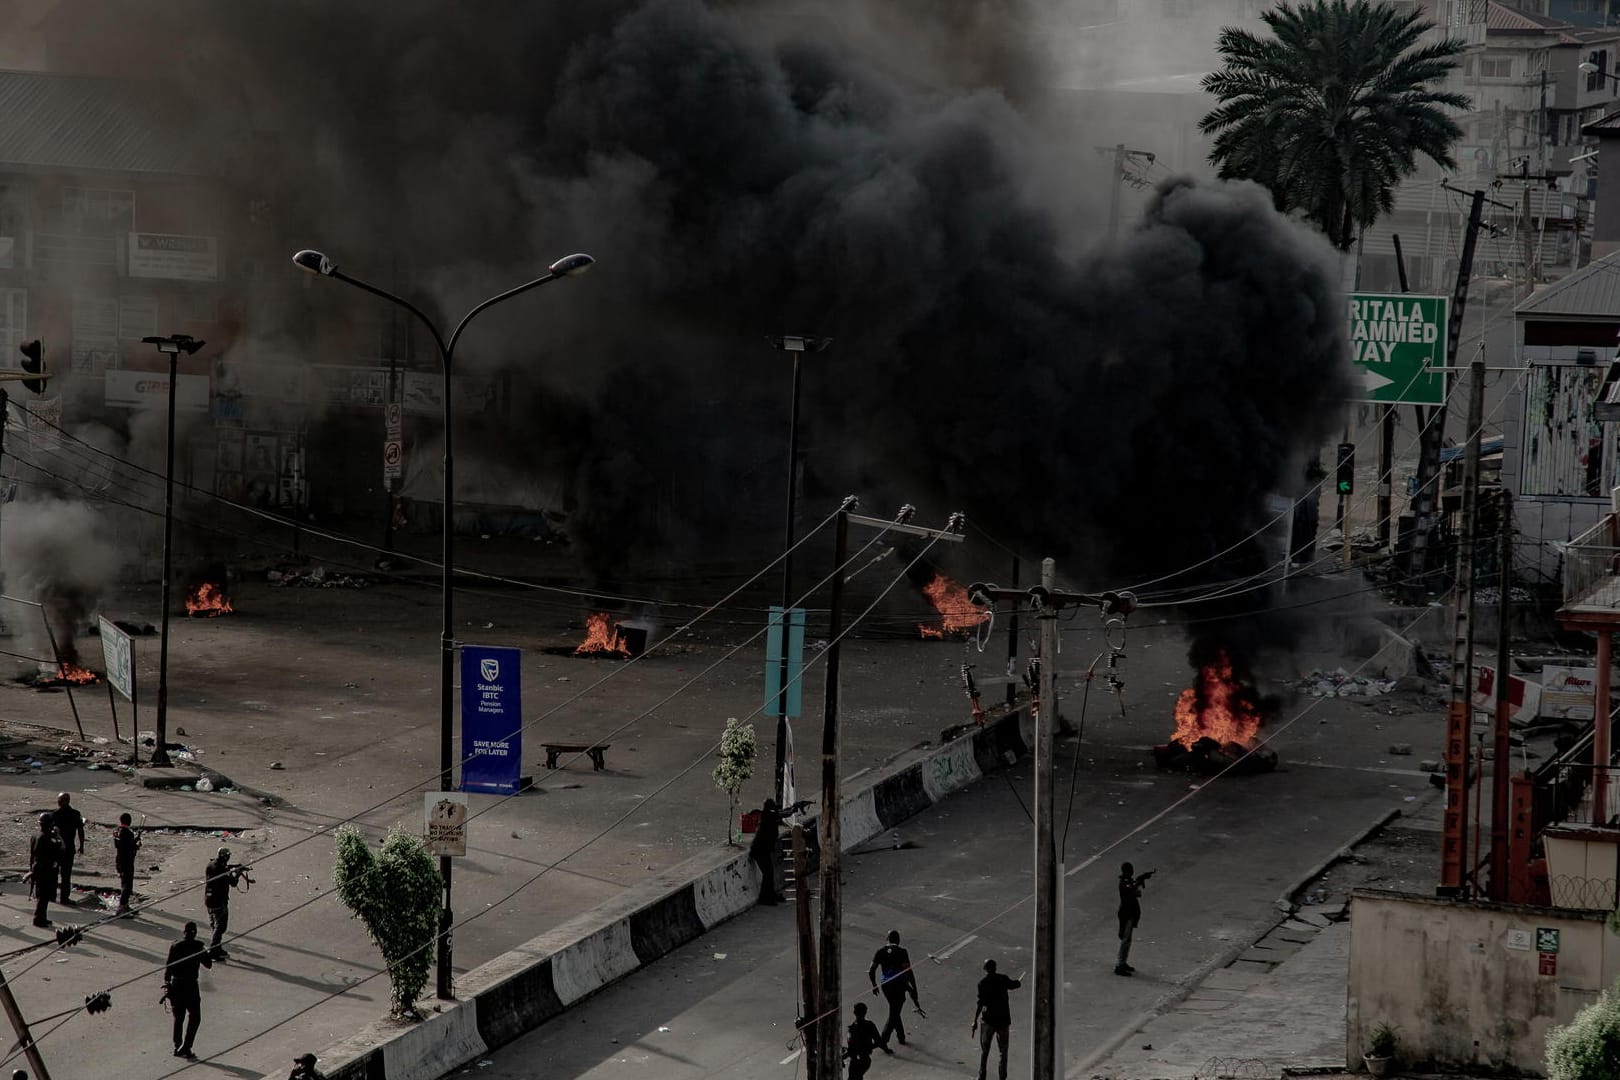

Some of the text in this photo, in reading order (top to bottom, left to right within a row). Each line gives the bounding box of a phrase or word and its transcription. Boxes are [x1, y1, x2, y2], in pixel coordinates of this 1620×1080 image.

[1347, 299, 1425, 323] RITALA
[477, 683, 504, 692] Stanbic
[482, 691, 499, 700] IBTC
[473, 740, 510, 749] SAVE MORE
[488, 748, 508, 756] LATER
